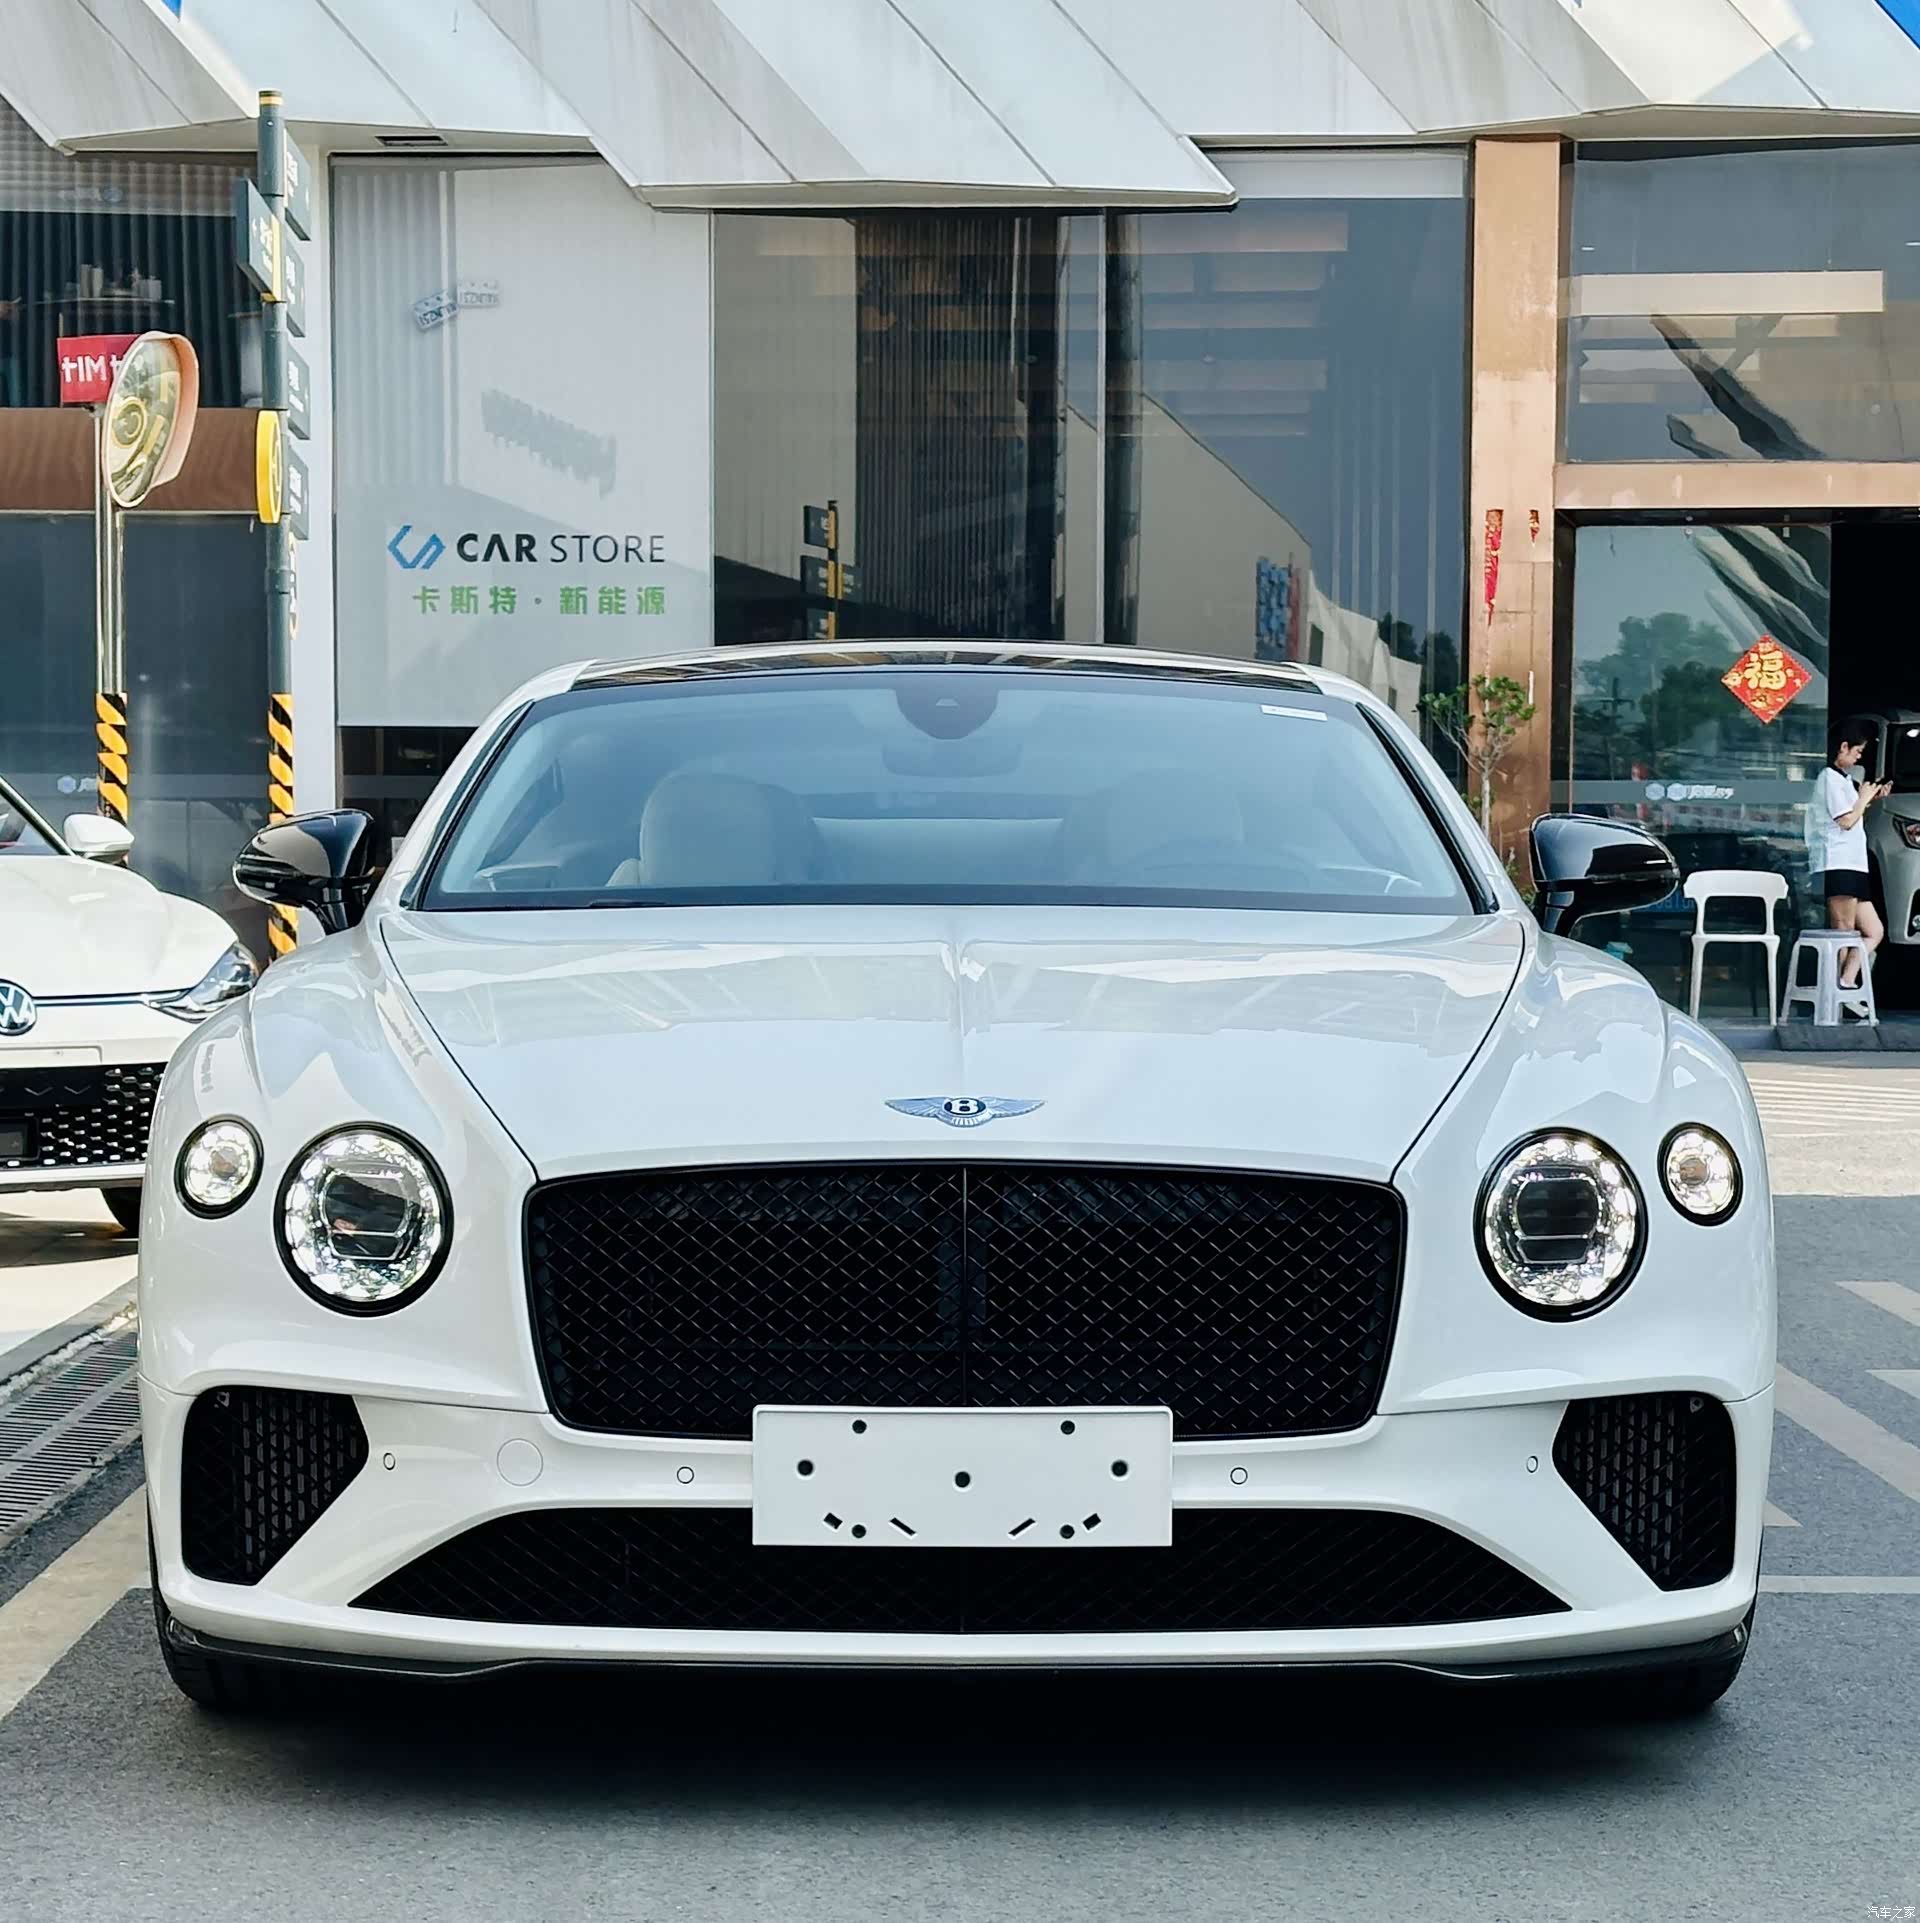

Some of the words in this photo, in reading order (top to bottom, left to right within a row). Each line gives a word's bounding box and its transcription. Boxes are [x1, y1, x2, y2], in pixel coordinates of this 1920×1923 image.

[456, 533, 538, 563] CAR
[549, 534, 666, 563] STORE
[1743, 650, 1787, 690] 福
